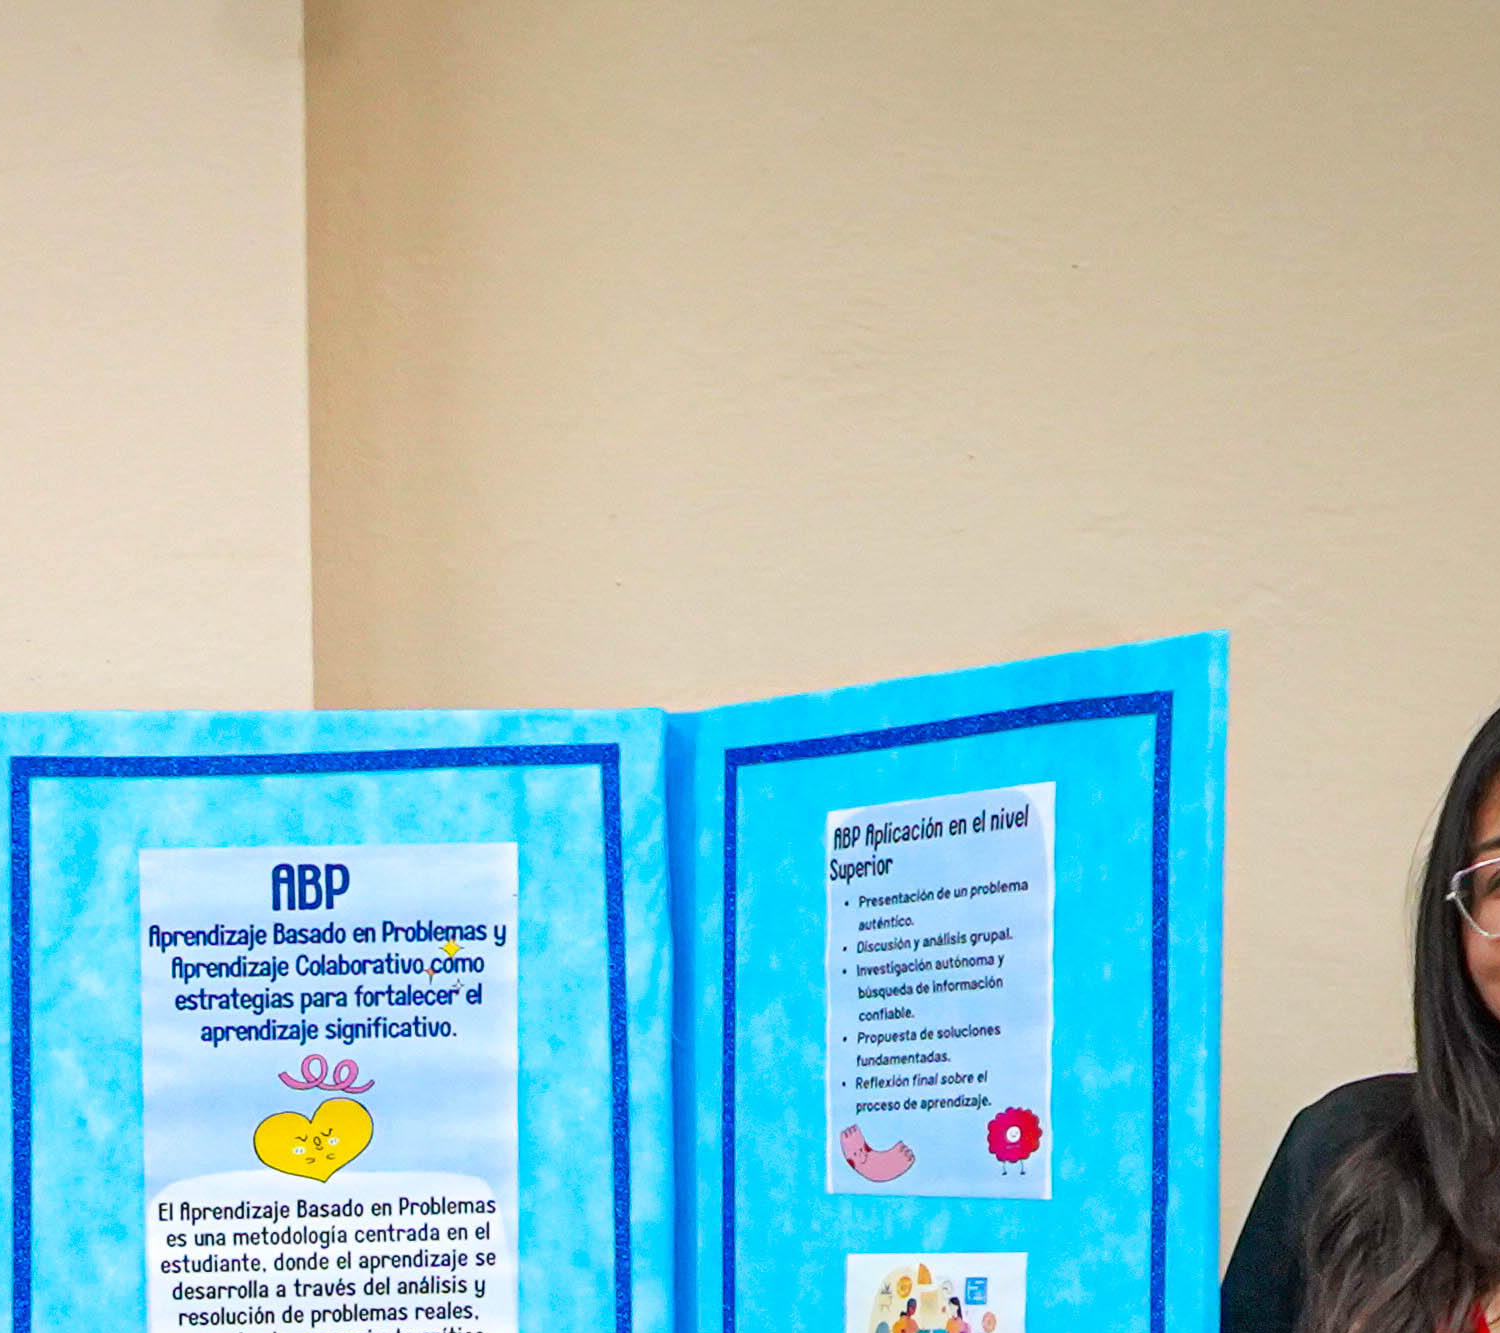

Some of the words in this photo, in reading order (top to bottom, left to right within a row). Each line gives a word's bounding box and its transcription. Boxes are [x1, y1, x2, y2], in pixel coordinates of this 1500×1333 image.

[272, 864, 350, 911] ABP
[149, 924, 267, 953] Aprendizaje
[274, 922, 346, 944] Basado
[353, 927, 375, 943] en
[382, 920, 487, 942] Problemas
[494, 925, 506, 946] y
[172, 956, 289, 984] Aprendizaje
[295, 953, 424, 976] Colaborativo
[430, 955, 484, 974] como
[175, 988, 294, 1015] estrategias
[301, 992, 347, 1014] para
[354, 984, 460, 1007] fortalecer
[466, 983, 482, 1005] el
[201, 1019, 318, 1048] aprendizaje
[326, 1016, 456, 1045] significativo.
[159, 1203, 173, 1221] El
[181, 1201, 289, 1226] Aprendizaje
[297, 1199, 363, 1218] Basado
[371, 1203, 392, 1216] en
[399, 1197, 496, 1215] Problemas
[167, 1234, 187, 1247] es
[195, 1233, 225, 1246] una
[233, 1225, 347, 1249] metodología
[355, 1223, 439, 1243] centrada
[448, 1227, 467, 1240] en
[475, 1222, 489, 1240] el
[161, 1254, 266, 1273] estudiante,
[274, 1252, 329, 1271] donde
[337, 1251, 351, 1269] el
[359, 1249, 467, 1279] aprendizaje
[476, 1253, 496, 1266] se
[173, 1280, 268, 1300] desarrolla
[277, 1285, 285, 1297] a
[294, 1278, 355, 1297] través
[364, 1277, 390, 1295] del
[398, 1276, 467, 1294] análisis
[475, 1280, 485, 1298] y
[179, 1306, 274, 1326] resolución
[282, 1305, 304, 1323] de
[311, 1304, 408, 1328] problemas
[415, 1301, 478, 1320] reales,
